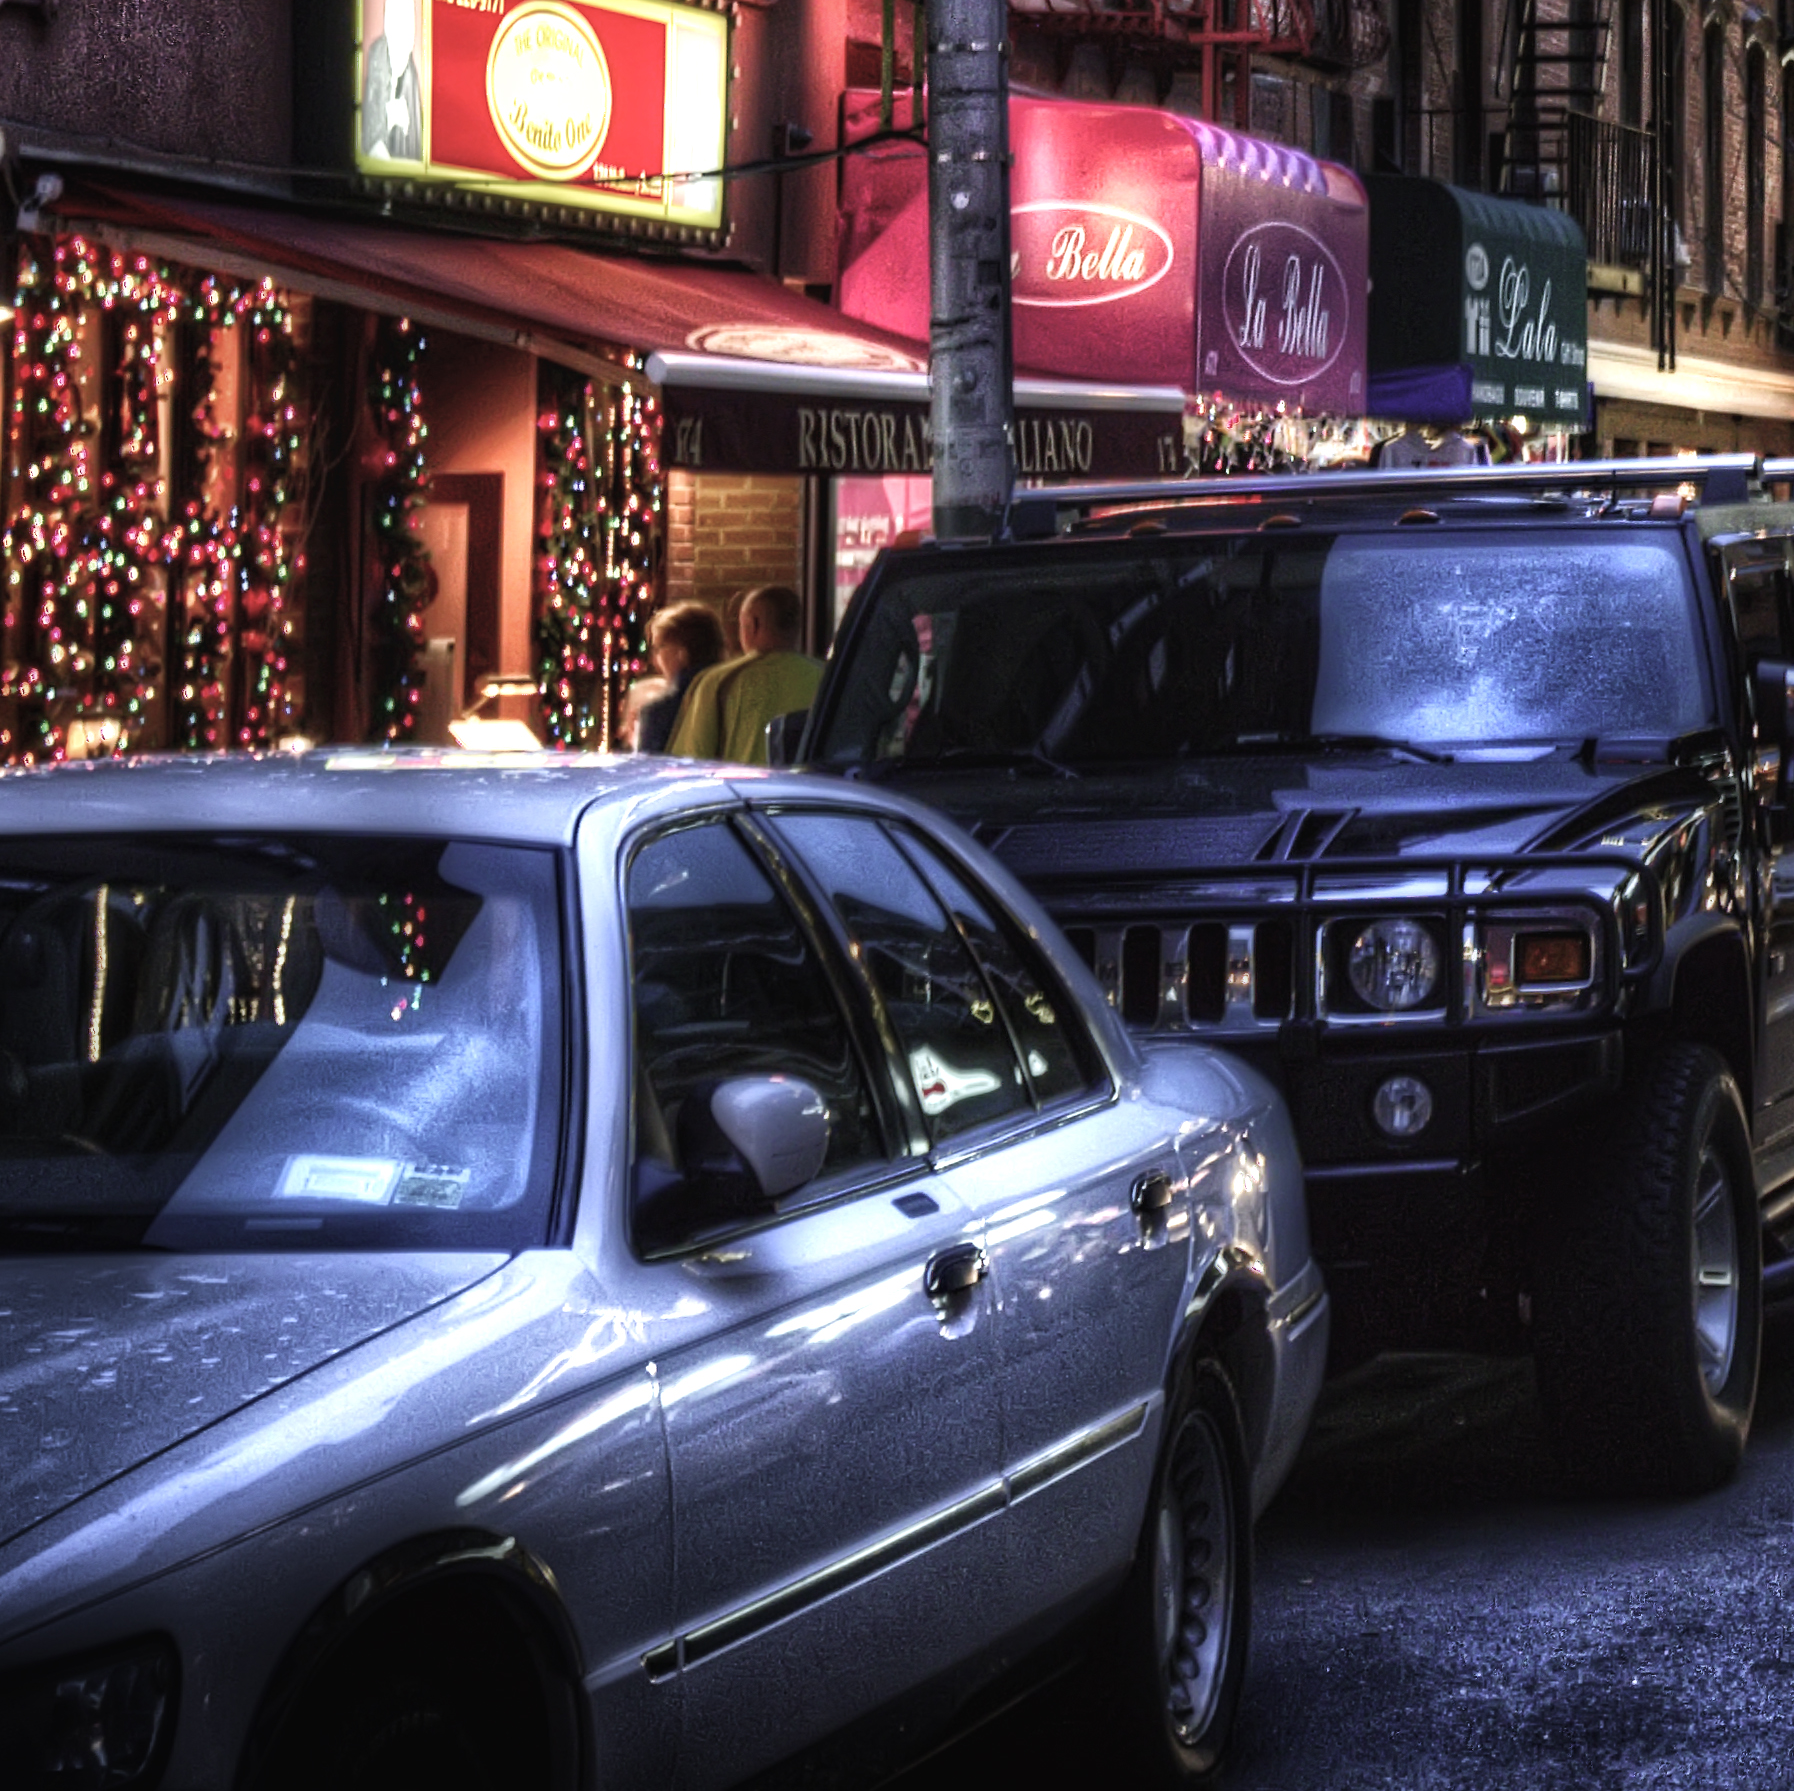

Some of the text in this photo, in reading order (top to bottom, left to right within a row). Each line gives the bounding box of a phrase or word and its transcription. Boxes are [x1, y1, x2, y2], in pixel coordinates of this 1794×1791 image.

[534, 27, 585, 69] ORIGINAL
[509, 98, 594, 152] Benito One
[1046, 224, 1147, 281] Bella
[1239, 245, 1330, 359] La Bella
